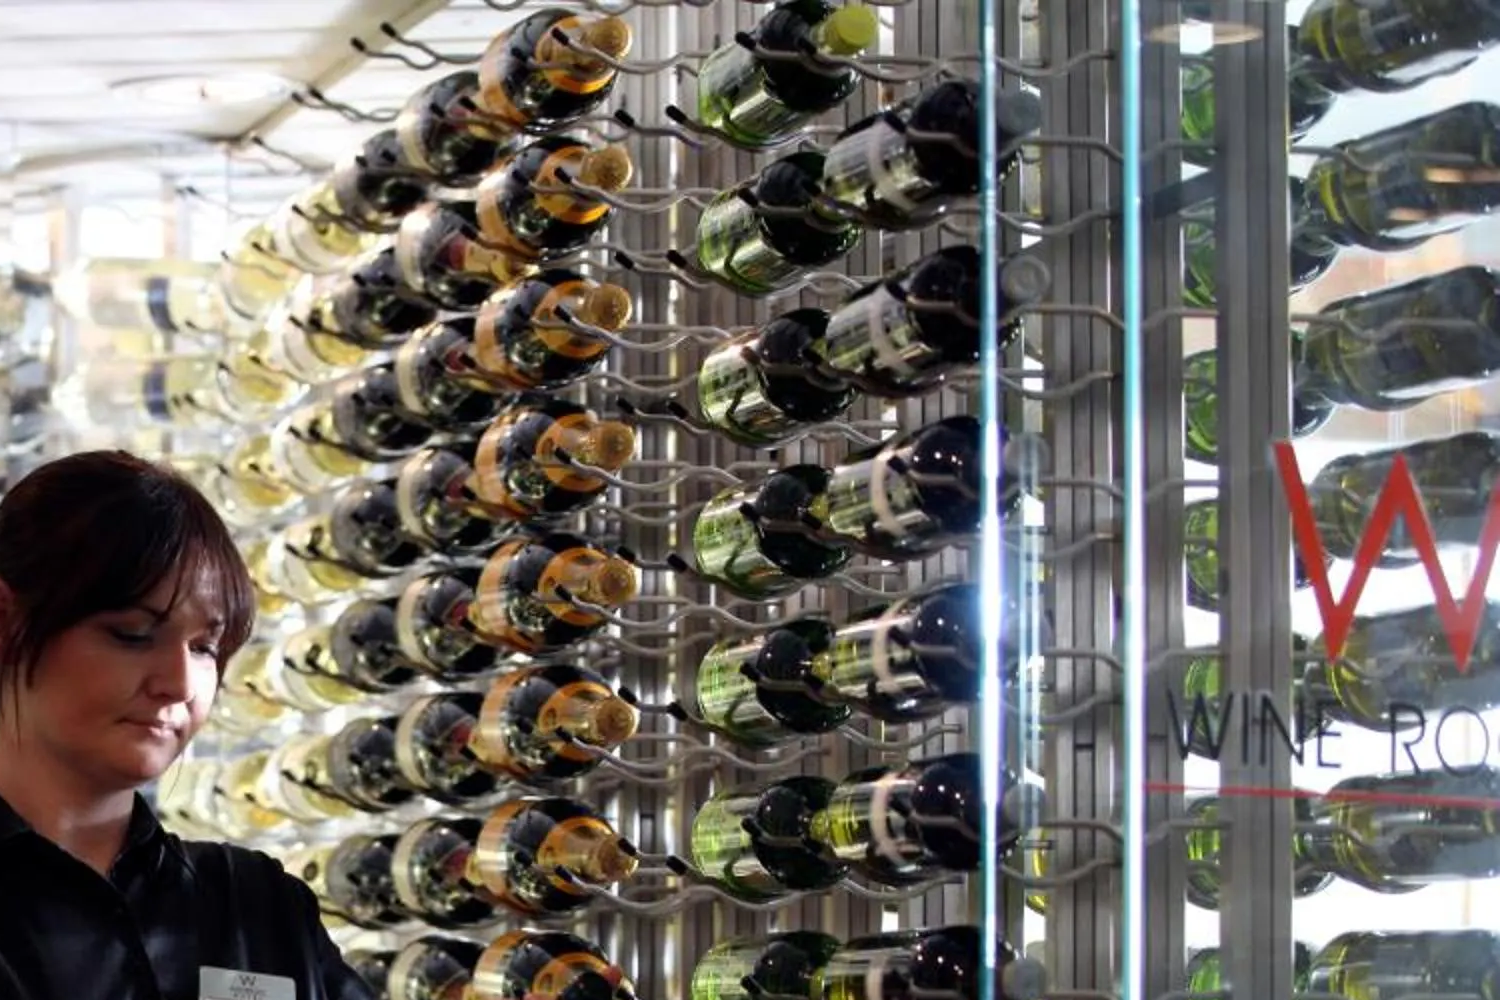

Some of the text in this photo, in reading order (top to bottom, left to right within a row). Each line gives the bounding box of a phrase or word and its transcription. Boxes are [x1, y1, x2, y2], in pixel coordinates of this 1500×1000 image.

[1272, 440, 1500, 674] W
[1166, 688, 1500, 776] WINE RO
